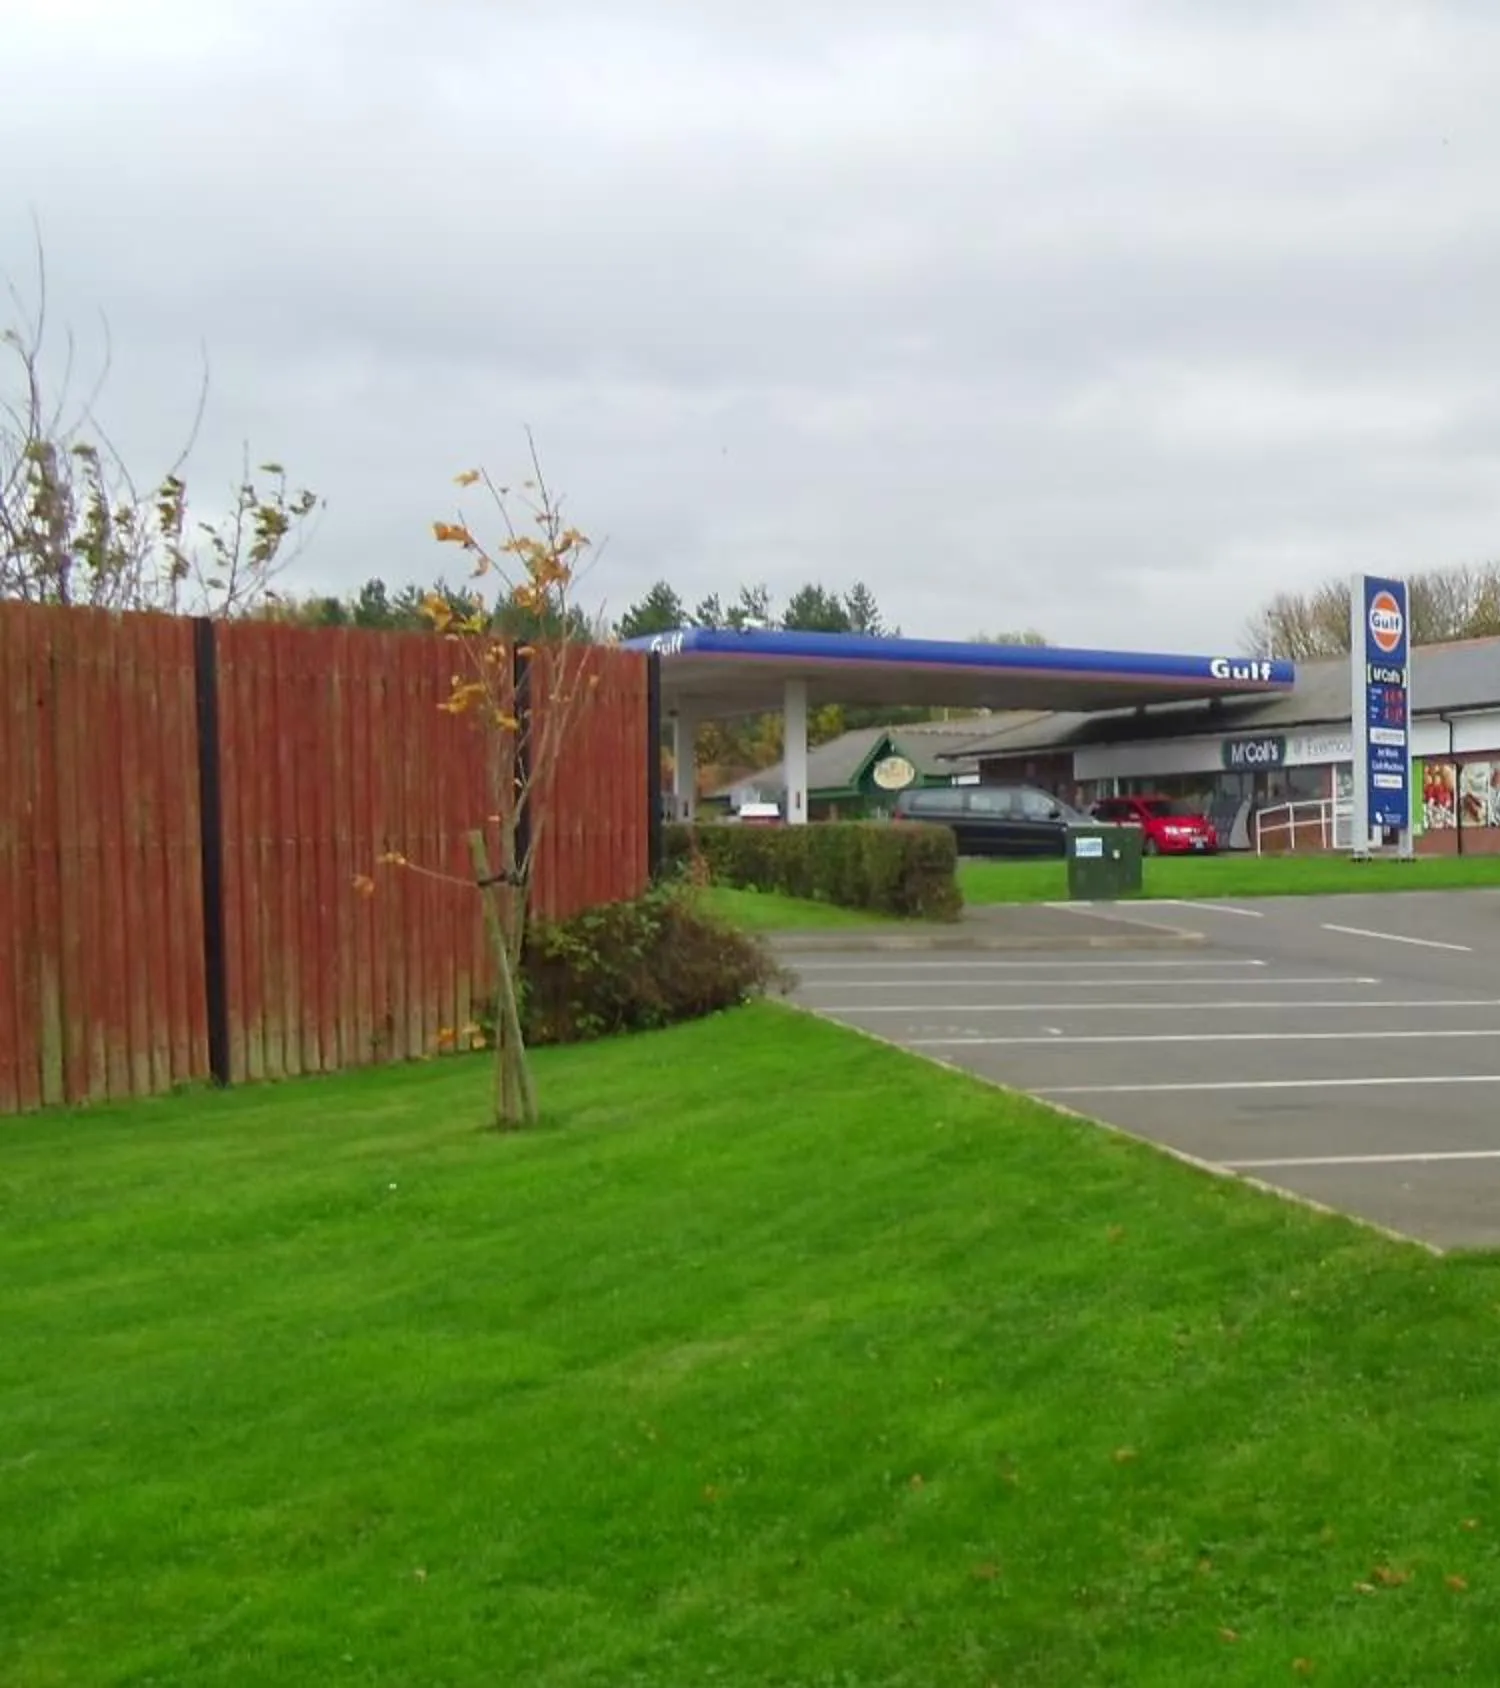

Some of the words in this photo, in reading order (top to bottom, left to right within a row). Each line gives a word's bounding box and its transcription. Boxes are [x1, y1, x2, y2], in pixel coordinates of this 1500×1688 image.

[1371, 611, 1401, 631] Gulf
[651, 631, 684, 656] Gulf
[1210, 658, 1271, 681] Gulf
